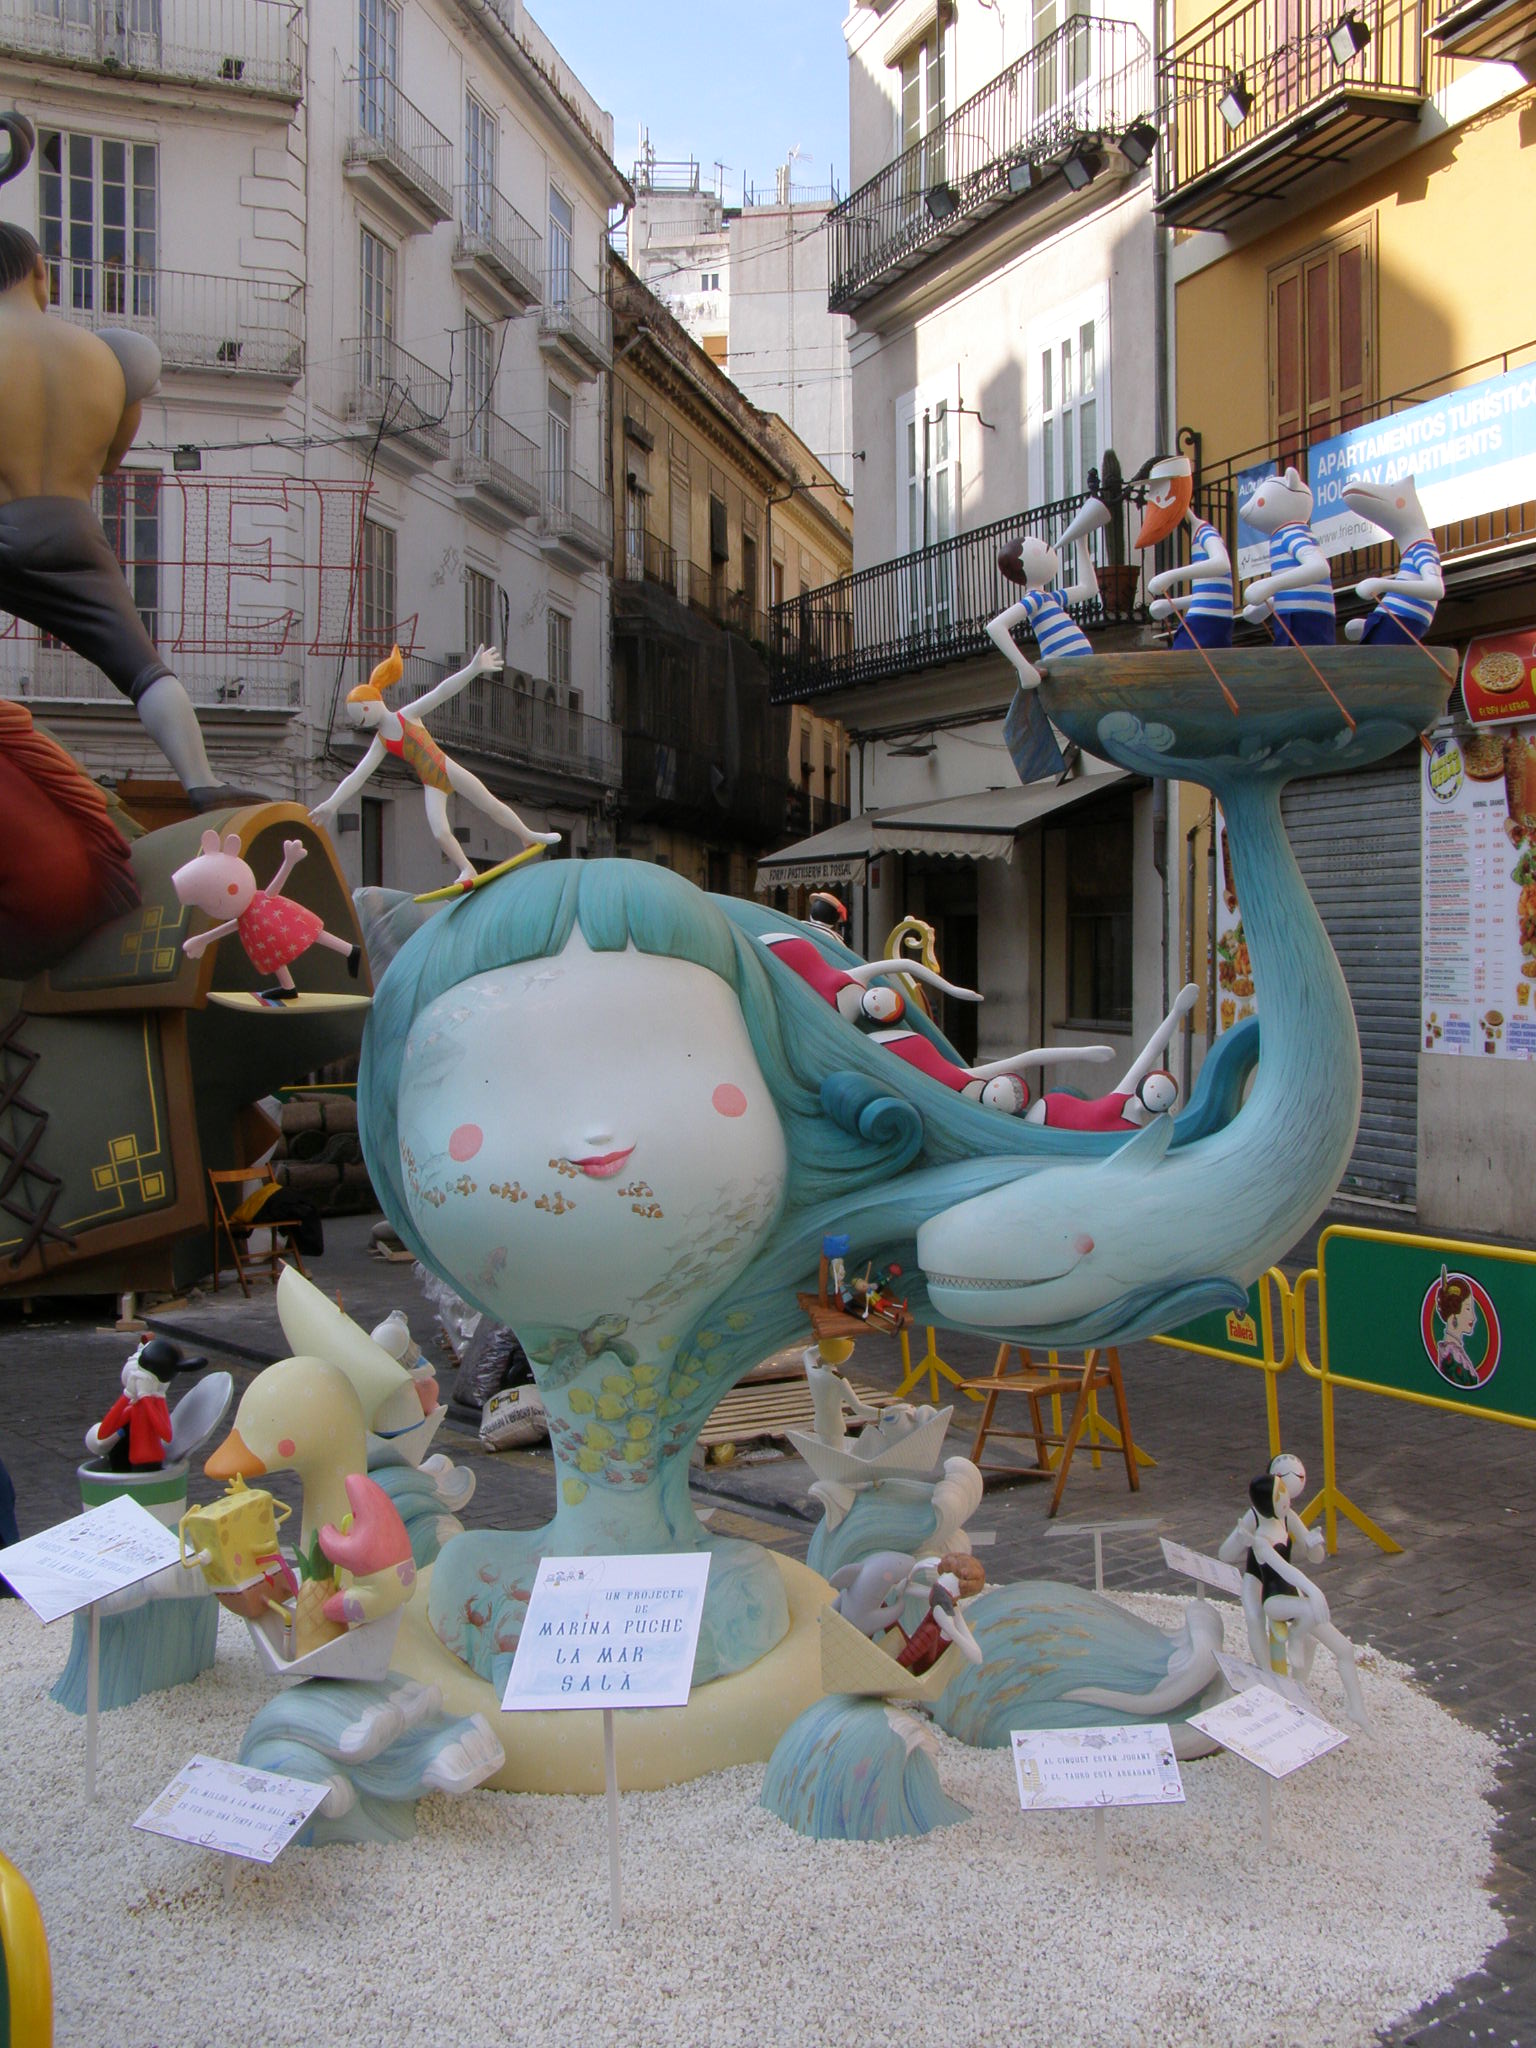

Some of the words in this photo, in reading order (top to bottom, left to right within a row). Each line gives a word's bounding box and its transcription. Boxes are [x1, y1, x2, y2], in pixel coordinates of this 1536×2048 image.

[1317, 411, 1447, 479] APARTAMENTOS
[1384, 423, 1502, 486] APARTMENTS
[1229, 1319, 1254, 1341] Fallera
[605, 1591, 621, 1601] UN
[627, 1589, 684, 1600] PROJECTE
[634, 1604, 649, 1614] DE
[538, 1620, 611, 1637] MARINA
[624, 1618, 683, 1634] PUCHE
[555, 1648, 581, 1665] LA
[596, 1646, 645, 1664] MAR
[1043, 1757, 1054, 1765] AL
[1050, 1772, 1061, 1781] EL
[189, 1786, 200, 1795] EL
[237, 1799, 249, 1807] LA
[249, 1803, 266, 1812] MAR
